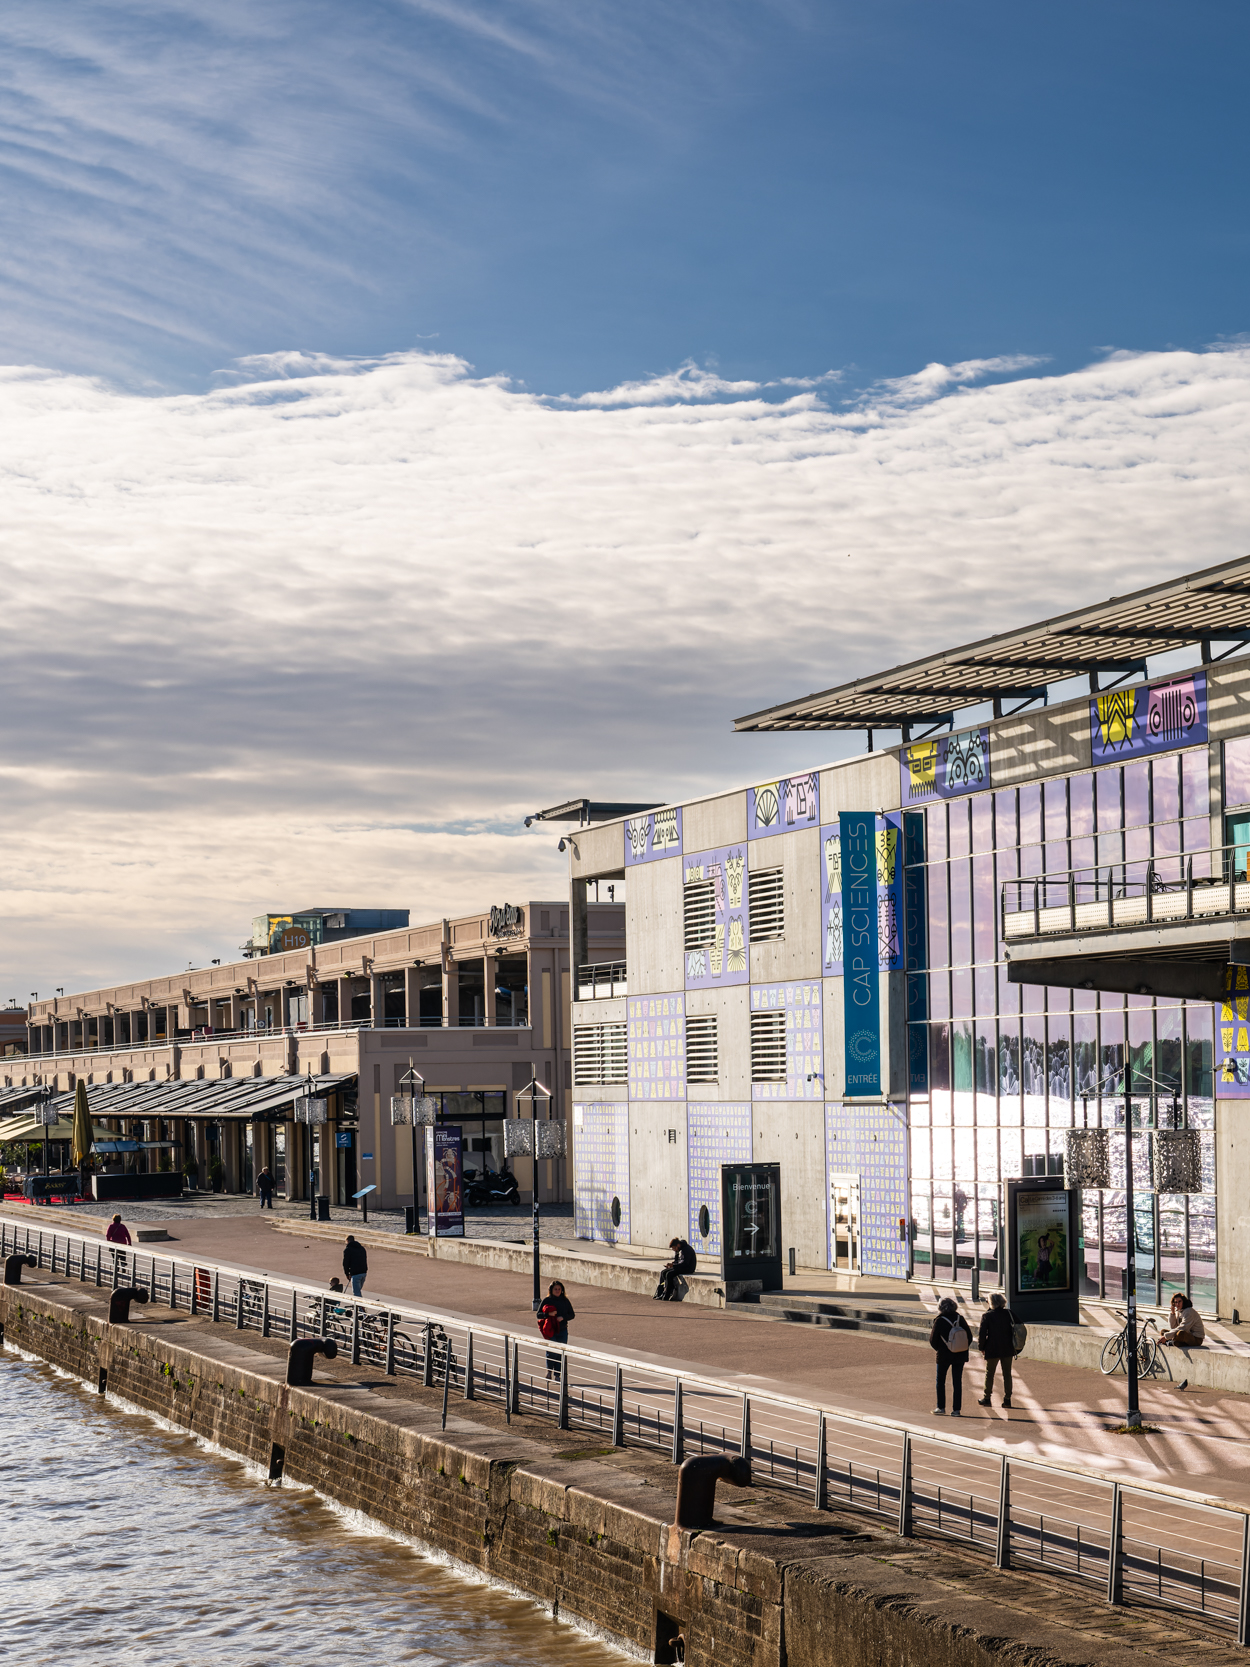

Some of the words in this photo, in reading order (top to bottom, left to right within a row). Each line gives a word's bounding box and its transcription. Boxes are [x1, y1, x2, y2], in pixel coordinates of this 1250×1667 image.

[849, 822, 870, 946] SCIENCES
[284, 935, 306, 947] H19
[853, 957, 871, 1006] CAP
[847, 1073, 878, 1084] ENTRÉE
